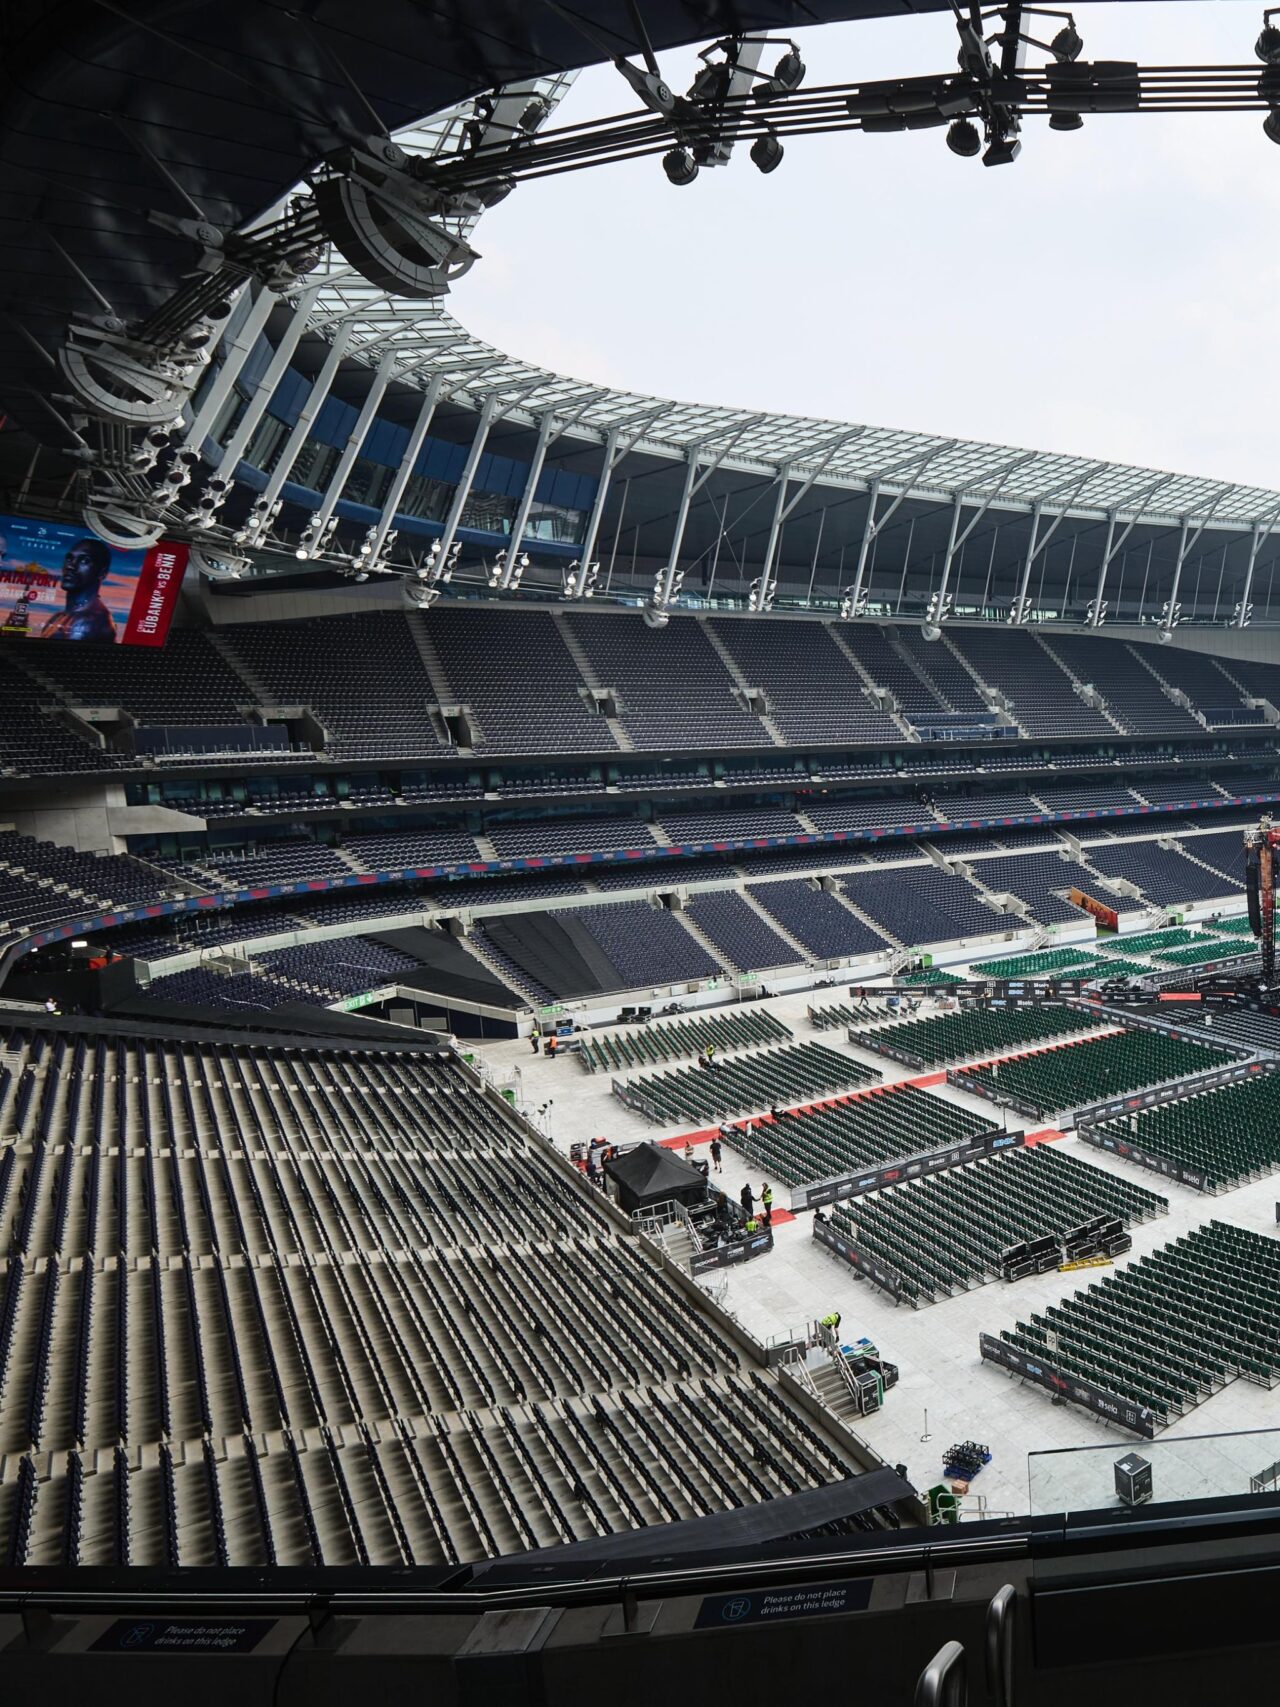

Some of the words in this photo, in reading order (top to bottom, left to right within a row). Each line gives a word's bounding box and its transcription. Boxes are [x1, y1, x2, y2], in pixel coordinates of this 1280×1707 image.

[142, 596, 165, 634] EUBANK
[157, 553, 177, 581] BENN
[764, 1595, 793, 1604] Please
[794, 1593, 805, 1601] do
[807, 1591, 822, 1599] not
[823, 1589, 847, 1599] place
[760, 1604, 789, 1615] drinks
[803, 1601, 819, 1610] this
[821, 1599, 846, 1608] ledge
[164, 1625, 193, 1635] Please
[193, 1626, 206, 1635] do
[205, 1626, 223, 1634] not
[219, 1625, 246, 1636] place
[154, 1637, 183, 1645] drinks
[194, 1637, 212, 1645] this
[211, 1637, 238, 1648] ledge
